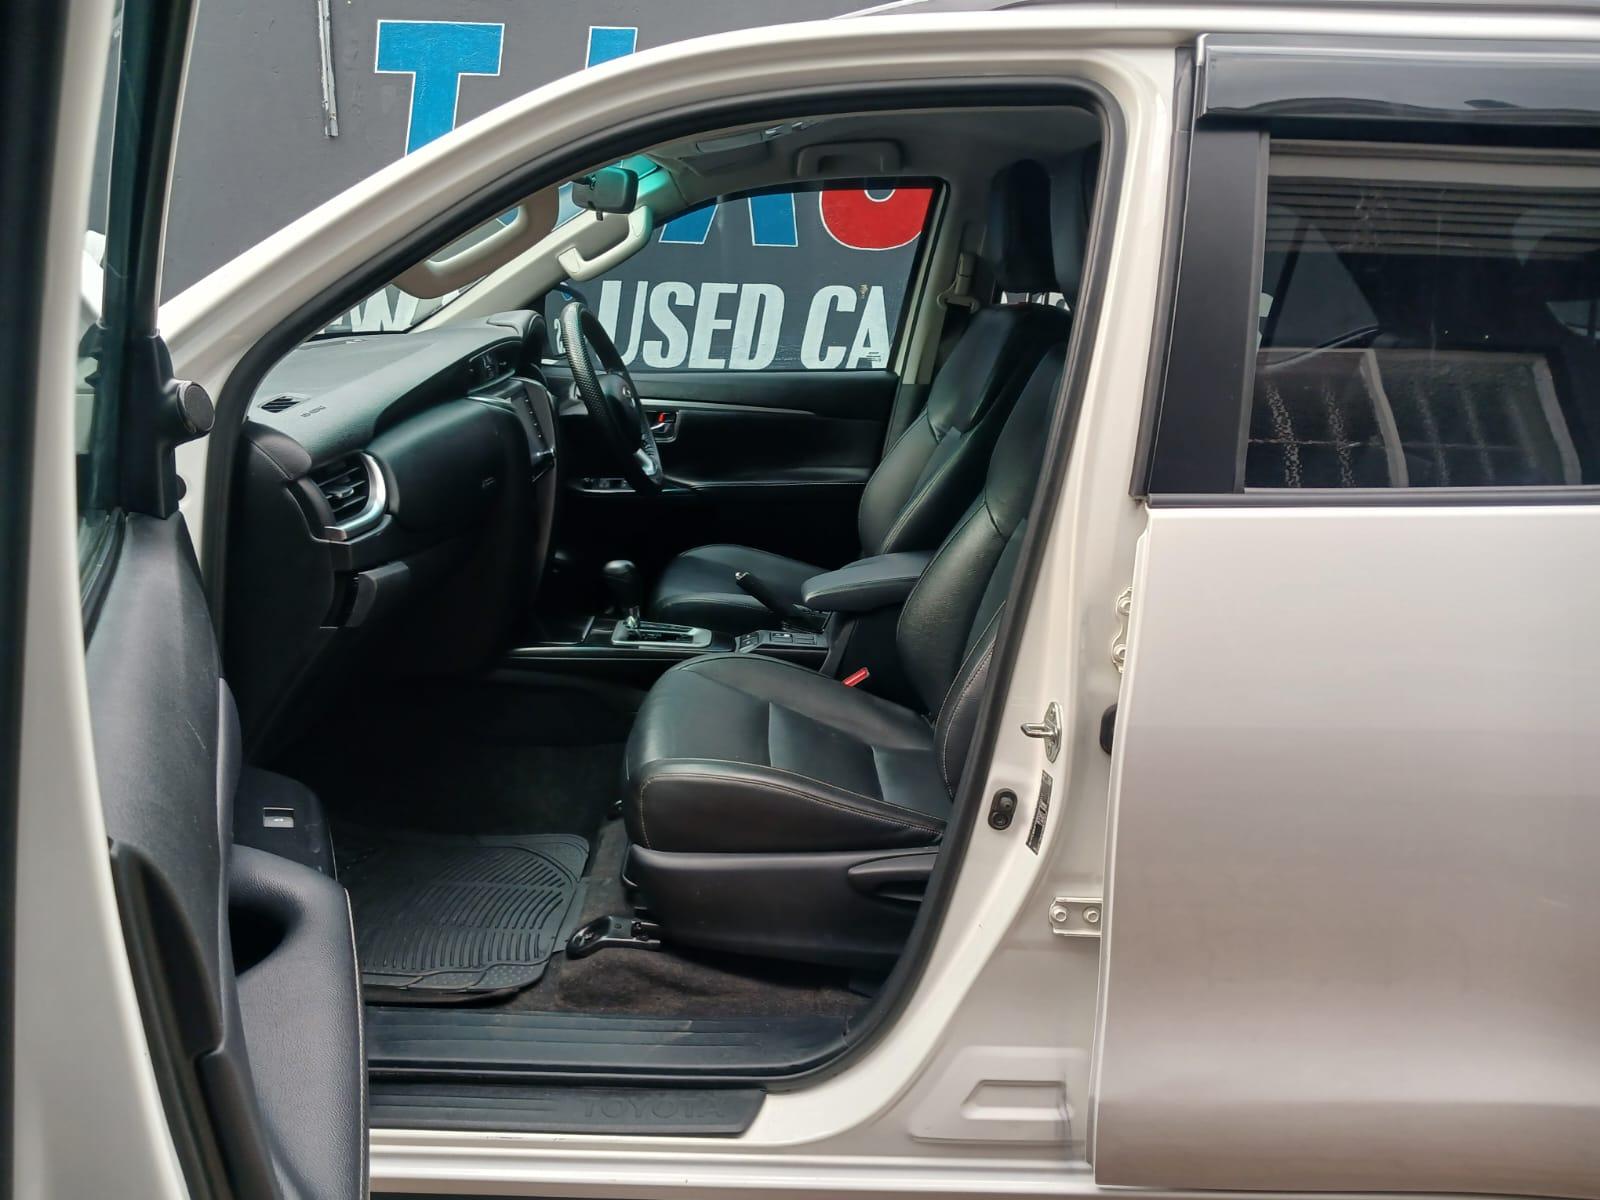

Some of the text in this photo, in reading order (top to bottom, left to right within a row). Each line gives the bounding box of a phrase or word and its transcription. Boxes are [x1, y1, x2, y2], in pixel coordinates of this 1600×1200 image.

[598, 280, 784, 370] USED
[801, 285, 892, 369] CA
[580, 1096, 724, 1118] TOYOTA
